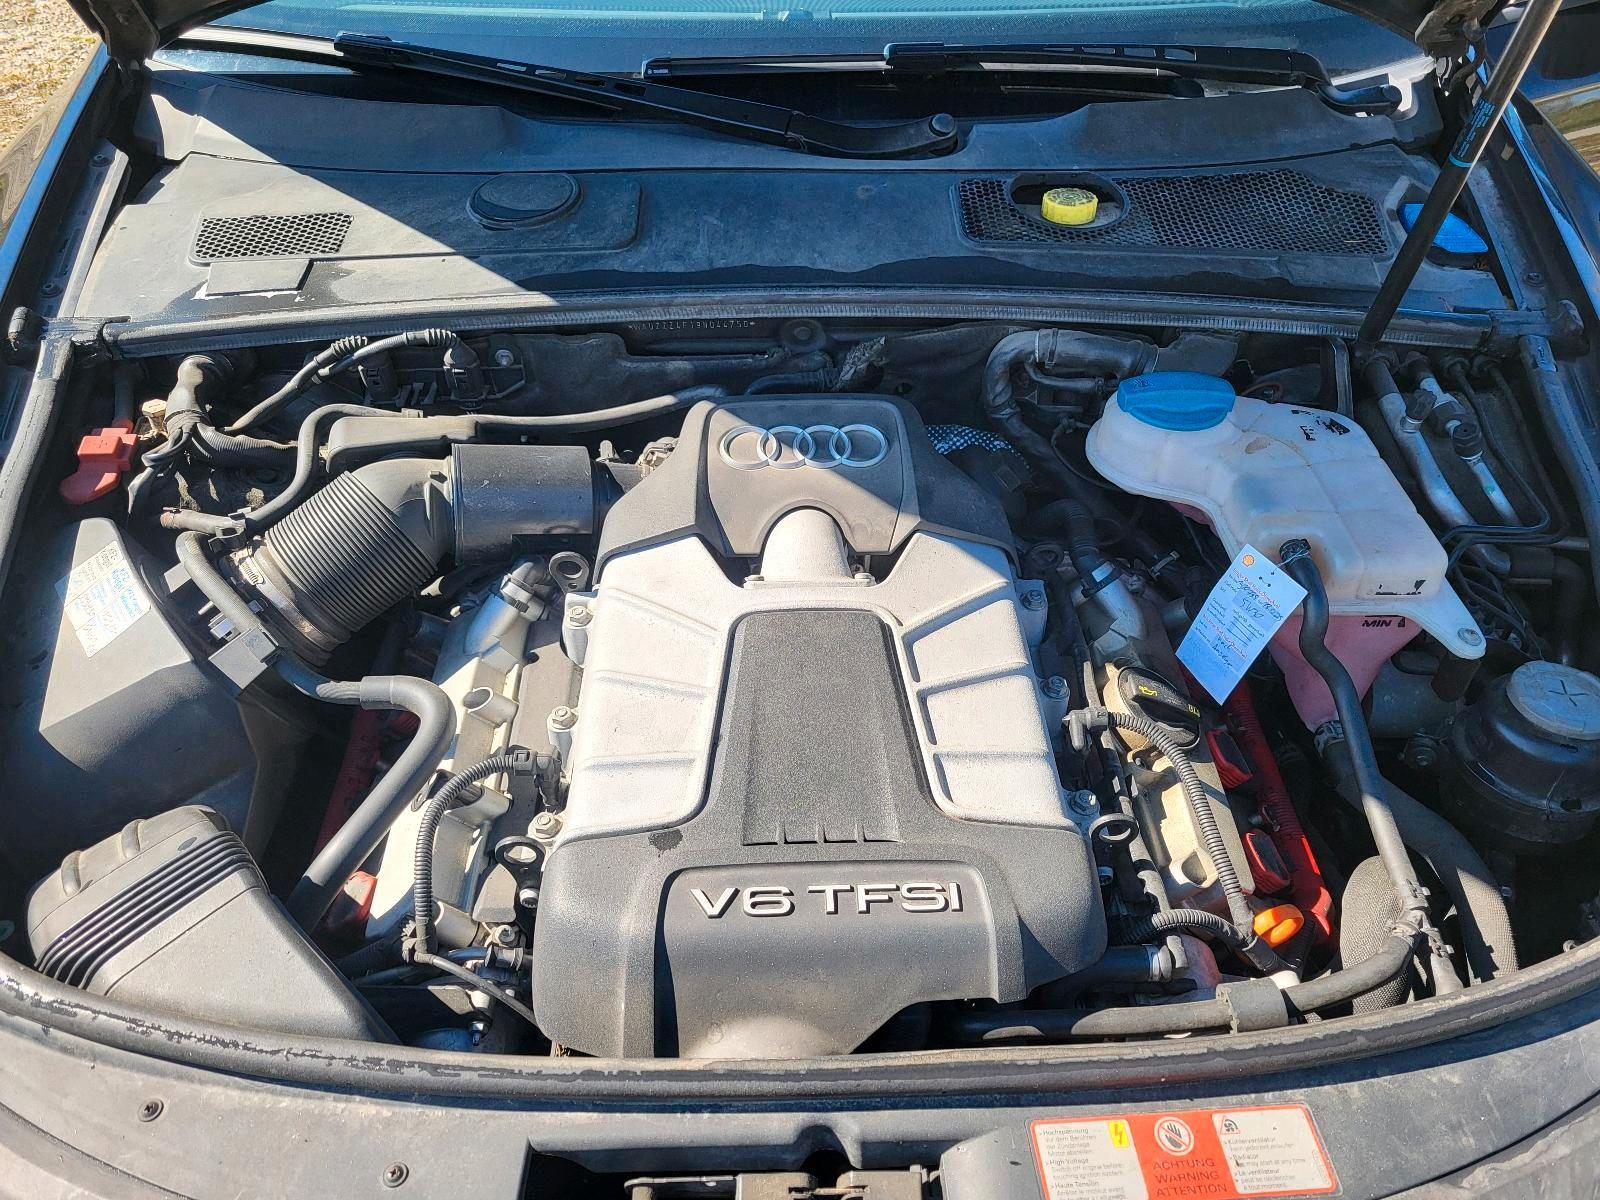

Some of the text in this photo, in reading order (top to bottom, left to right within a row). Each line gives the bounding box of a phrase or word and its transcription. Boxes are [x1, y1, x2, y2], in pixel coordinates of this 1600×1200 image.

[1362, 619, 1392, 628] MIN
[690, 882, 964, 918] V6 TFSI
[1153, 1158, 1216, 1170] ACHTUNG
[1155, 1170, 1220, 1183] WARNING
[1157, 1184, 1228, 1197] ATTENTION
